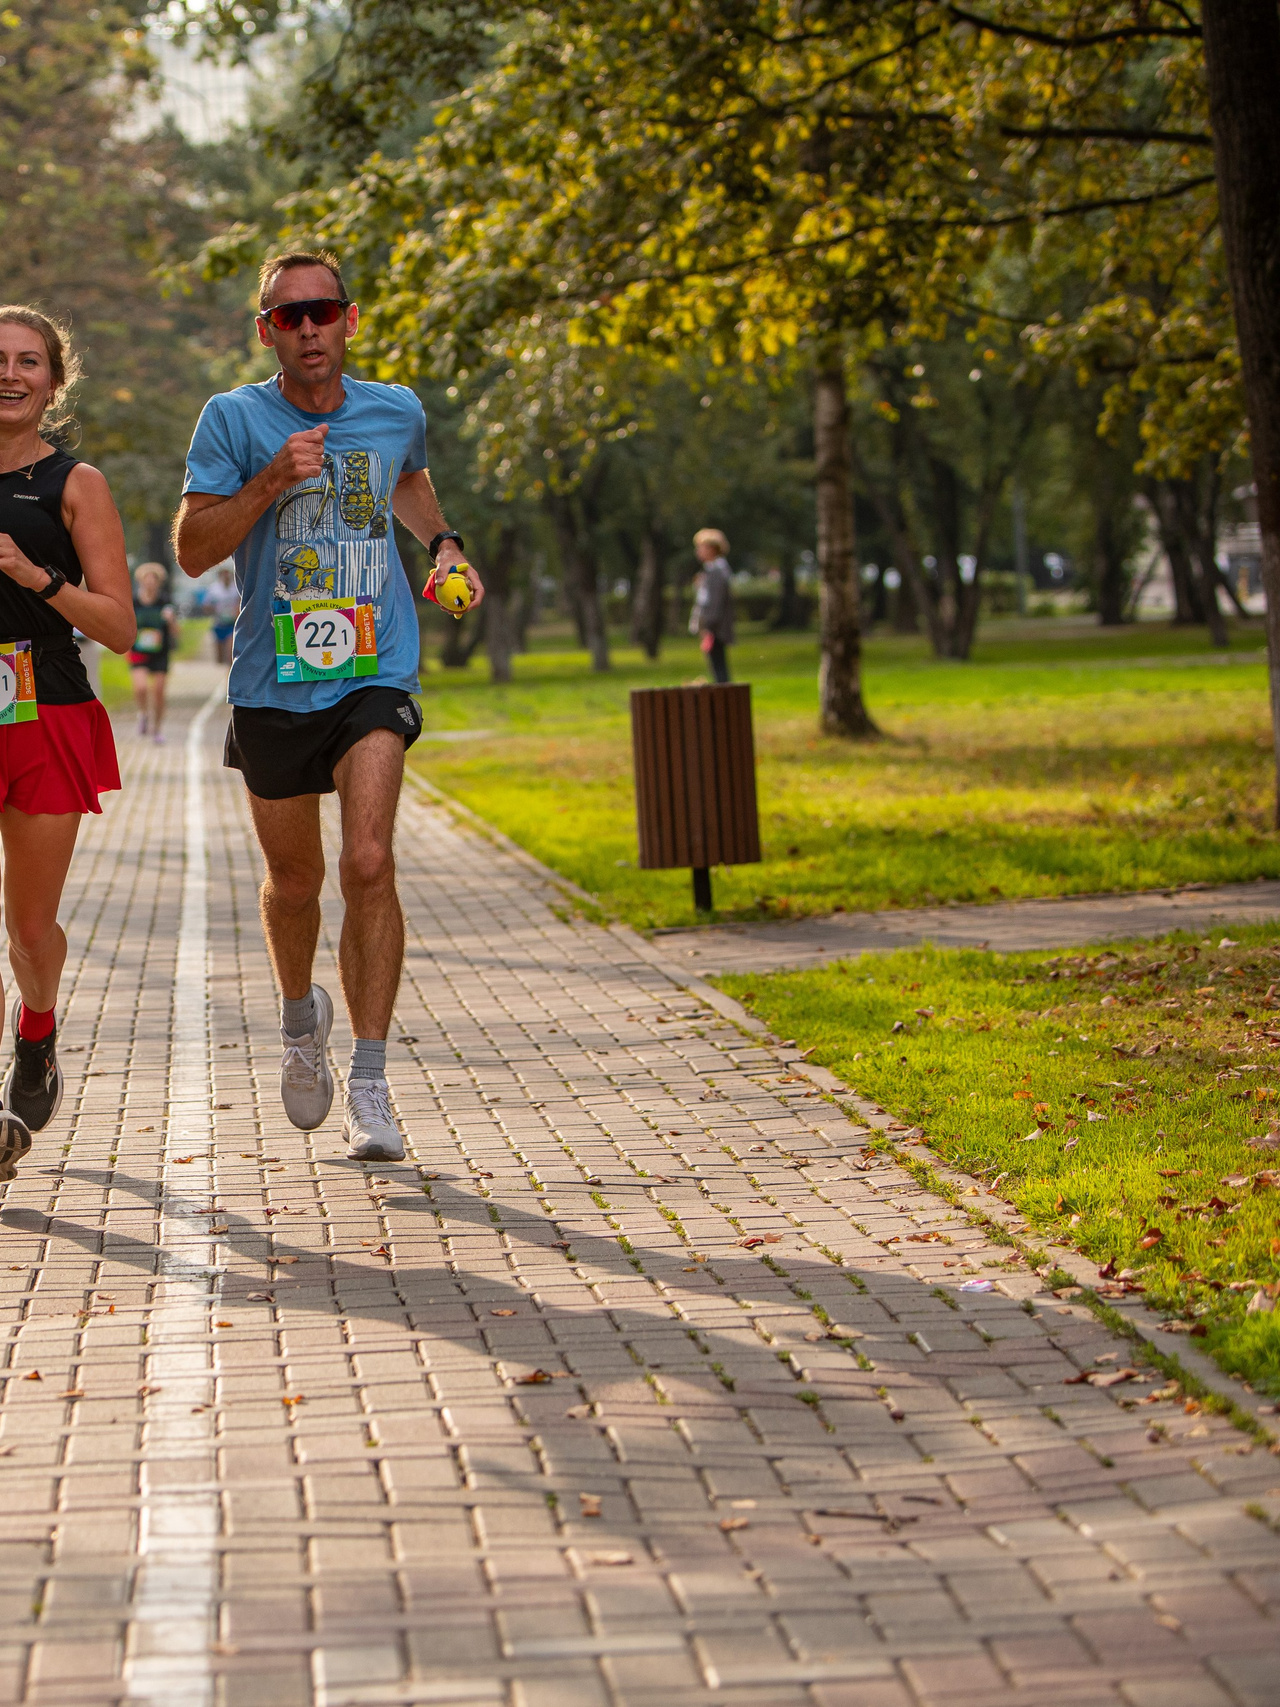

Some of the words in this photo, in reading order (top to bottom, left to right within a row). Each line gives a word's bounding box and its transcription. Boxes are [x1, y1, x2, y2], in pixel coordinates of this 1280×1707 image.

[13, 493, 40, 501] DEMIX
[313, 602, 329, 610] TRAIL
[304, 620, 337, 649] 22
[341, 629, 348, 646] 1
[363, 612, 373, 650] ЭСТАФЕТА
[22, 658, 32, 695] ЭСТАФЕТА
[302, 662, 327, 677] KANNAS
[336, 665, 347, 675] ЛЕС
[1, 674, 9, 692] 1
